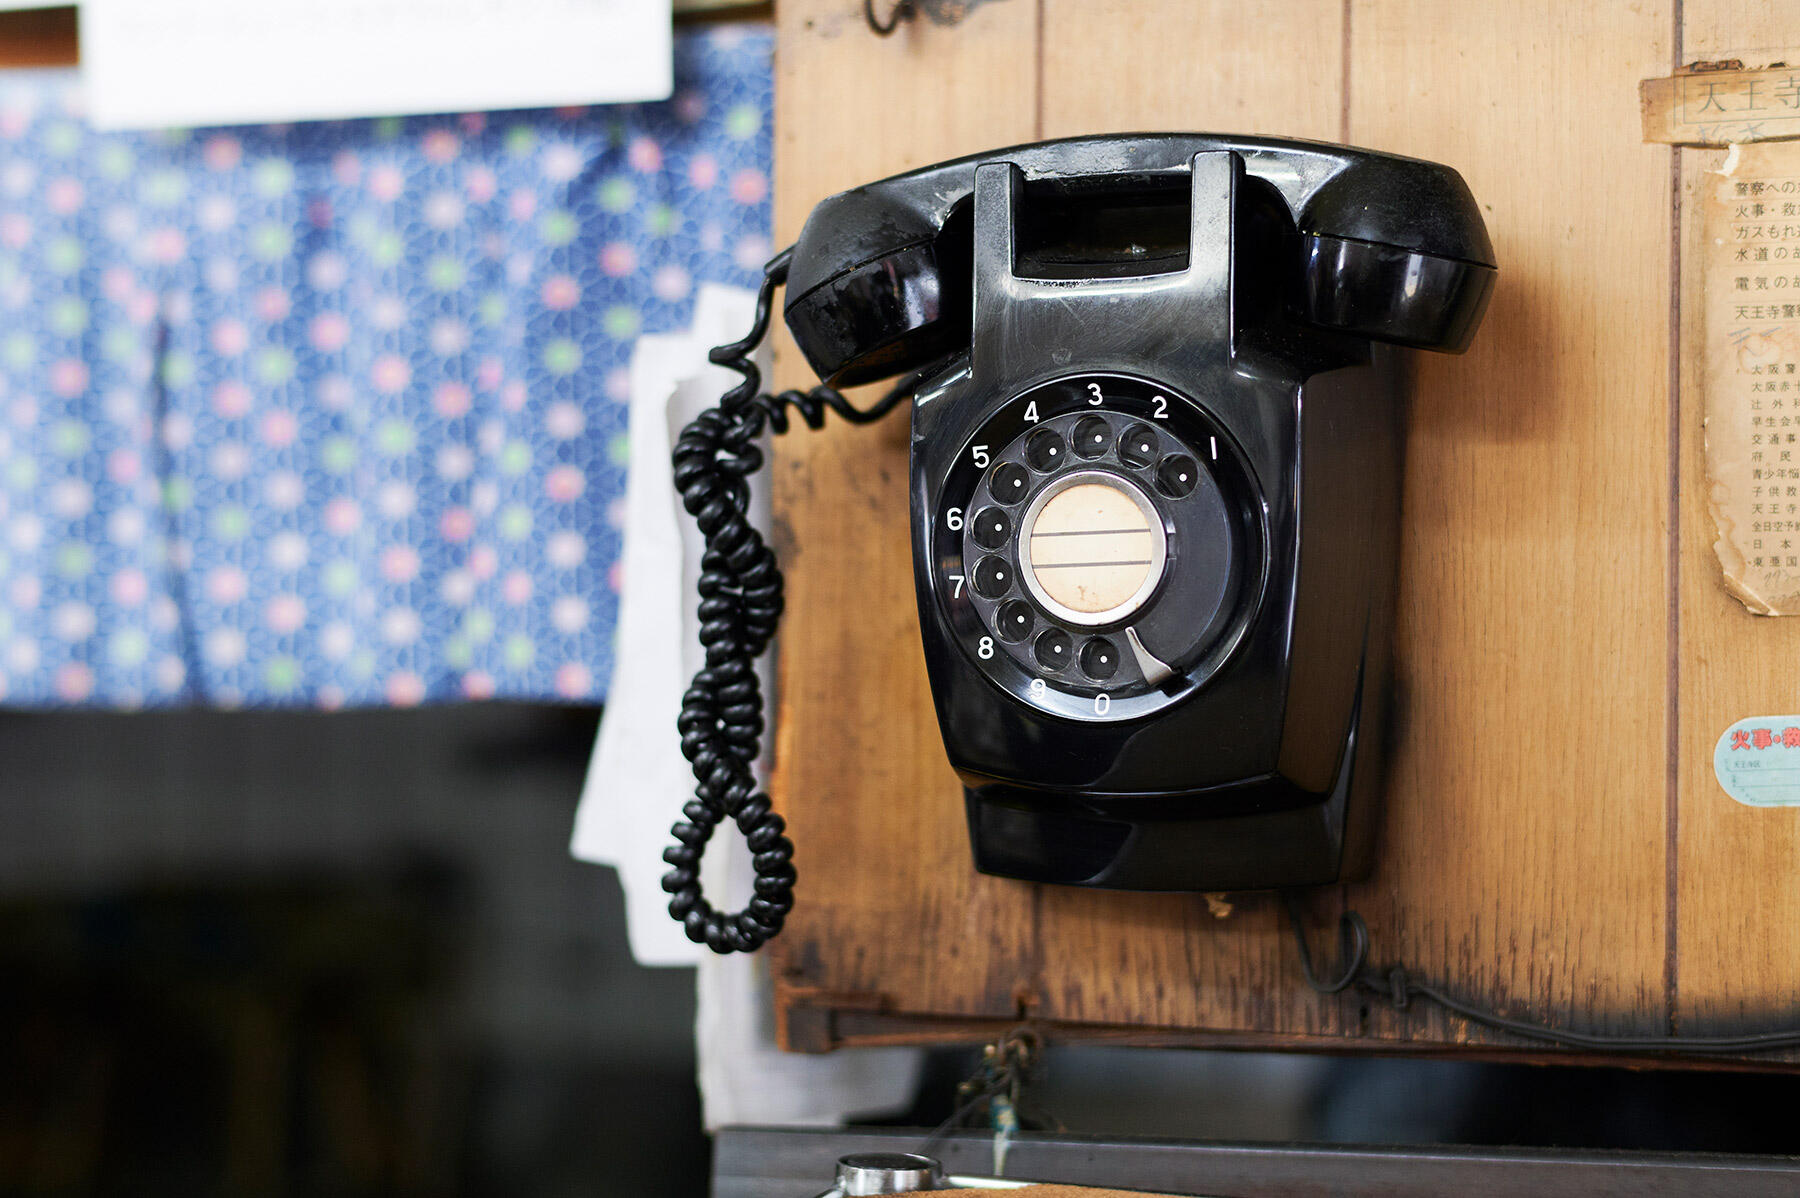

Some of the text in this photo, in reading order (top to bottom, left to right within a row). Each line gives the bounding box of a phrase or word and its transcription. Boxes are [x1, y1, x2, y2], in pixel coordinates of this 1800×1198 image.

[1735, 181, 1800, 196] 警察への
[1735, 203, 1800, 218] 火事・救
[1736, 225, 1800, 240] ガスもれ
[1735, 304, 1800, 320] 天王寺警
[1087, 383, 1103, 405] 3
[1023, 401, 1039, 423] 4
[1152, 396, 1169, 418] 2
[972, 445, 990, 468] 5
[1210, 436, 1217, 460] 1
[946, 508, 964, 531] 6
[949, 575, 966, 599] 7
[977, 636, 994, 660] 8
[1030, 678, 1047, 700] 9
[1094, 693, 1110, 716] 0
